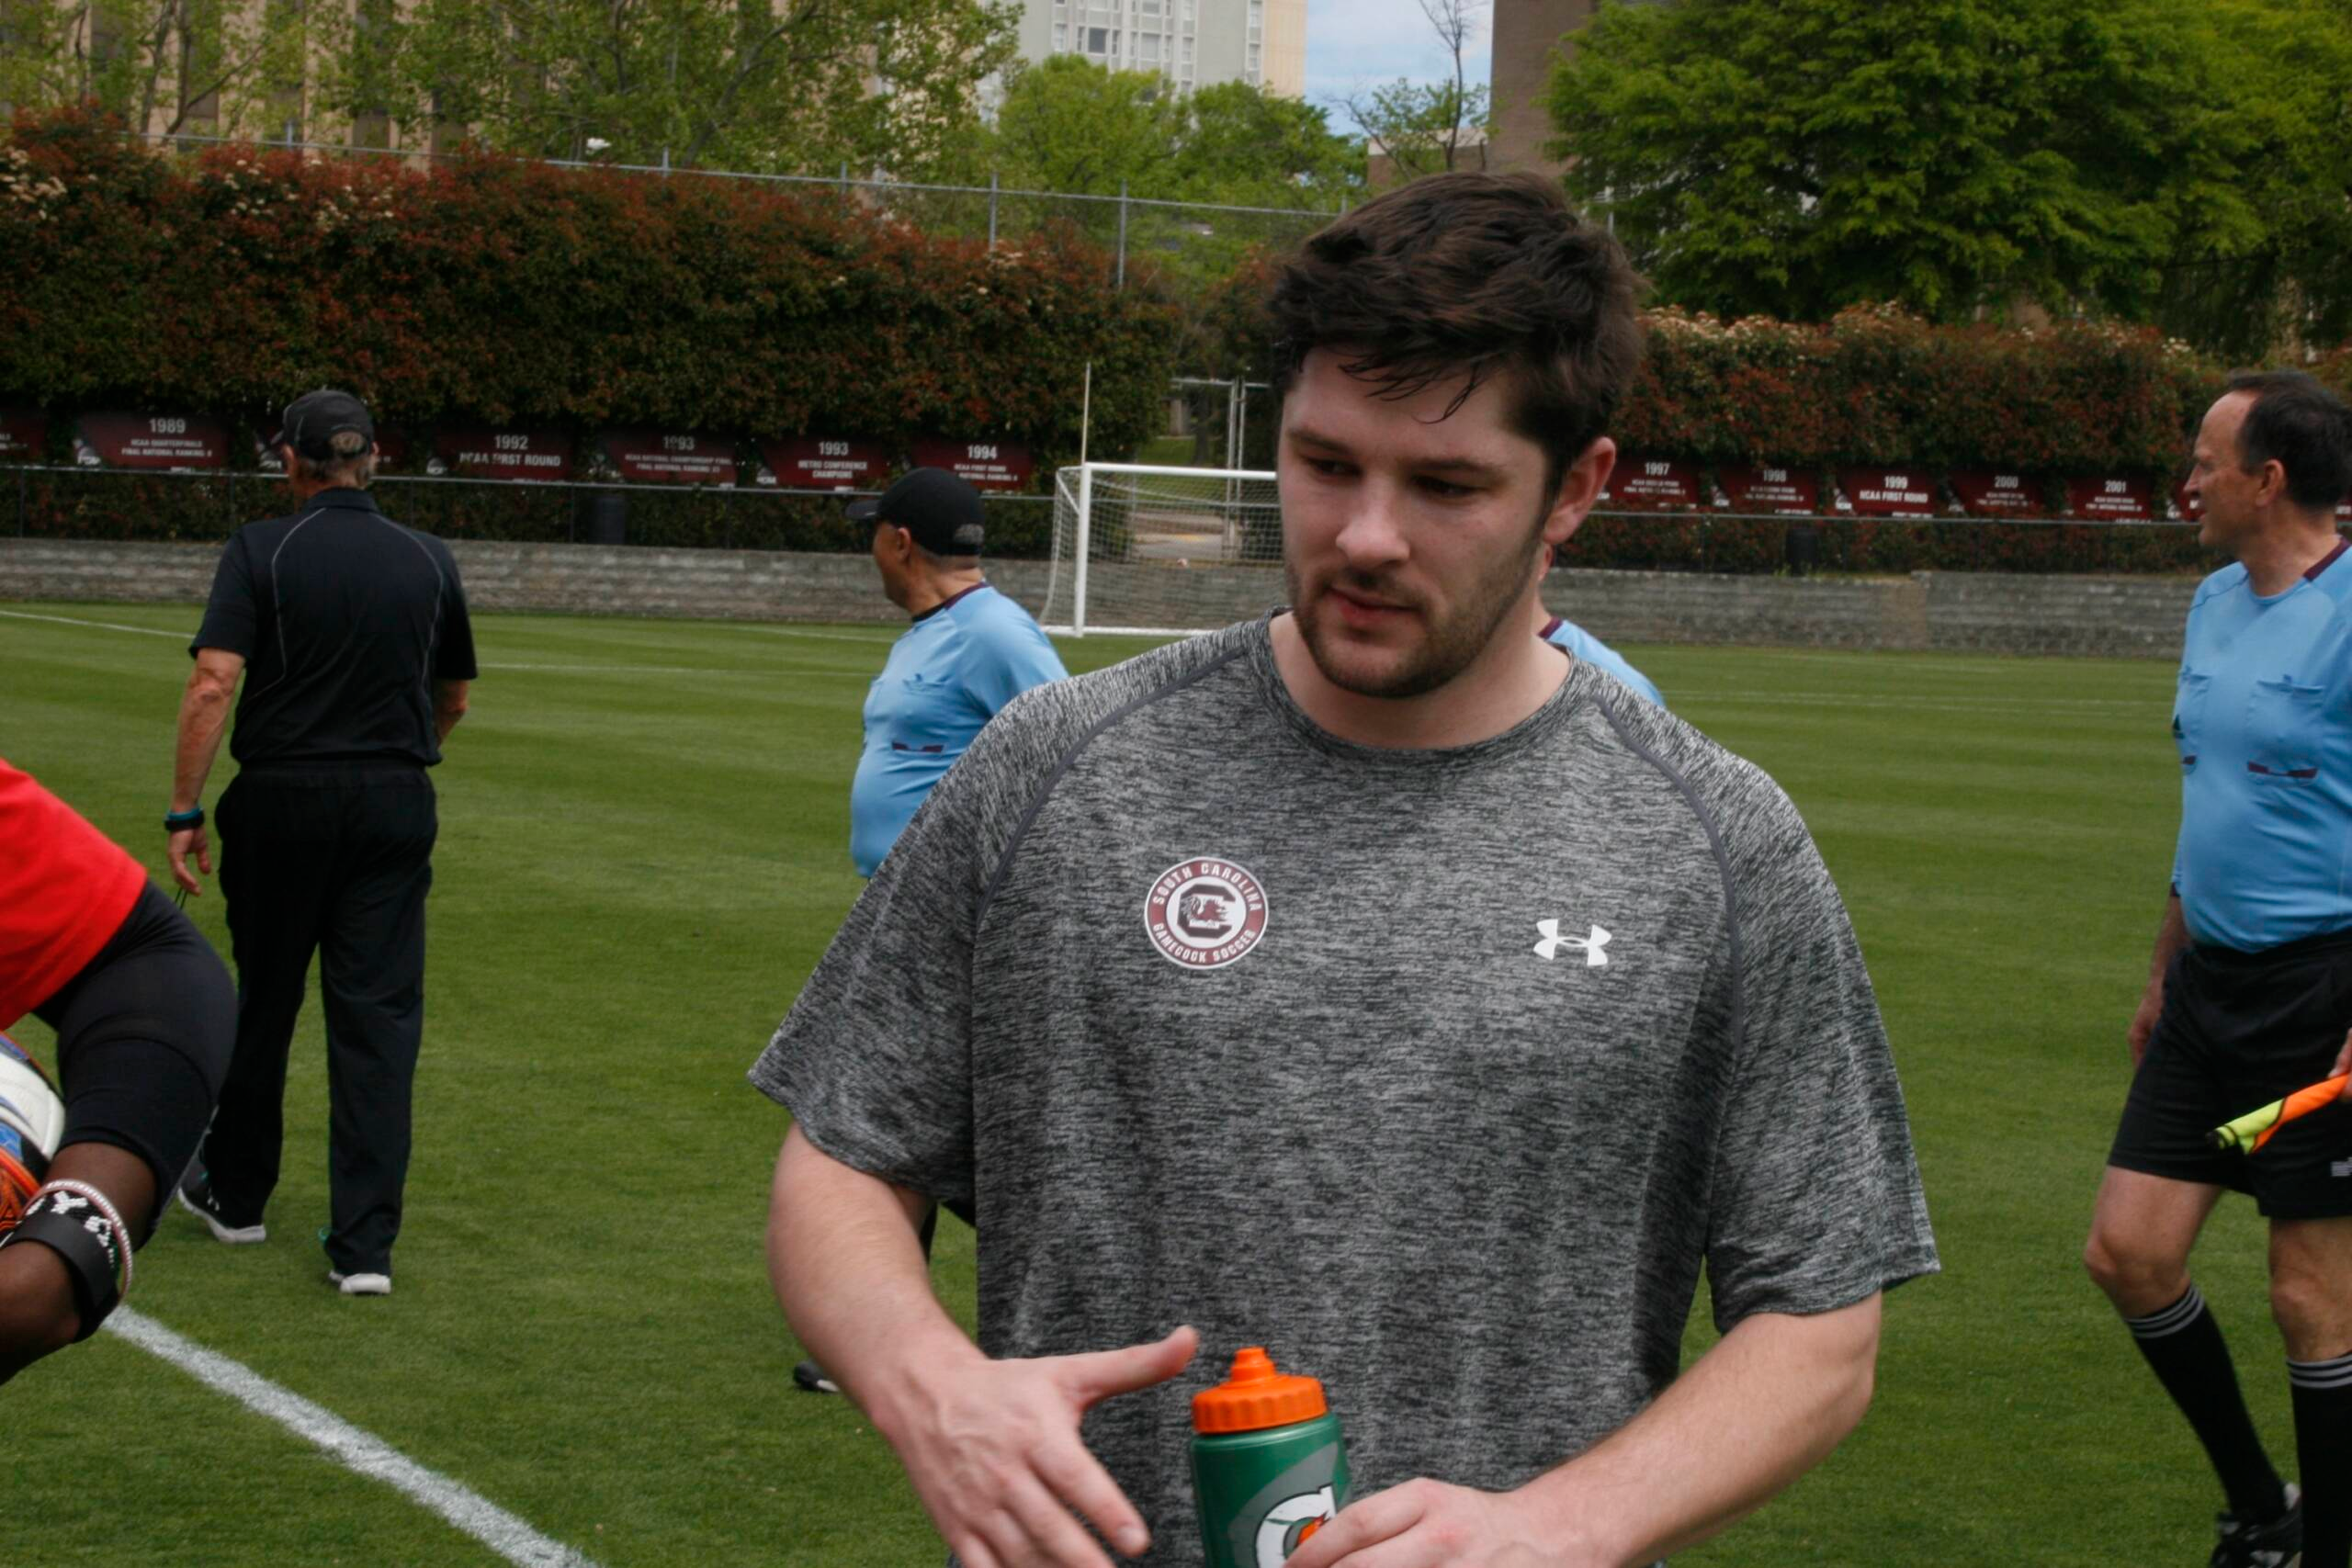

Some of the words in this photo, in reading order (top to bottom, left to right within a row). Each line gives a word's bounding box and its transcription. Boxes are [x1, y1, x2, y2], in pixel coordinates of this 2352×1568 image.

[149, 418, 187, 434] 1989
[494, 434, 529, 450] 1992
[662, 435, 695, 451] 1993
[819, 441, 849, 457] 1993
[967, 445, 998, 460] 1994
[525, 455, 561, 467] ROUND
[797, 460, 822, 469] METRO
[823, 460, 868, 470] CONFERENCE
[812, 470, 854, 479] CHAMPIONS
[1645, 461, 1671, 476] 1997
[1763, 469, 1787, 482] 1998
[1884, 476, 1908, 490] 1999
[1994, 475, 2019, 489] 2000
[2105, 479, 2127, 493] 2001
[1860, 490, 1881, 501] NCAA
[1882, 491, 1903, 502] FIRST
[1904, 492, 1928, 504] ROUND
[1152, 866, 1193, 906] SOUTH
[1200, 862, 1263, 911] CAROLINA
[1152, 922, 1207, 964] GAMECOCK
[1212, 929, 1257, 963] SOCCER
